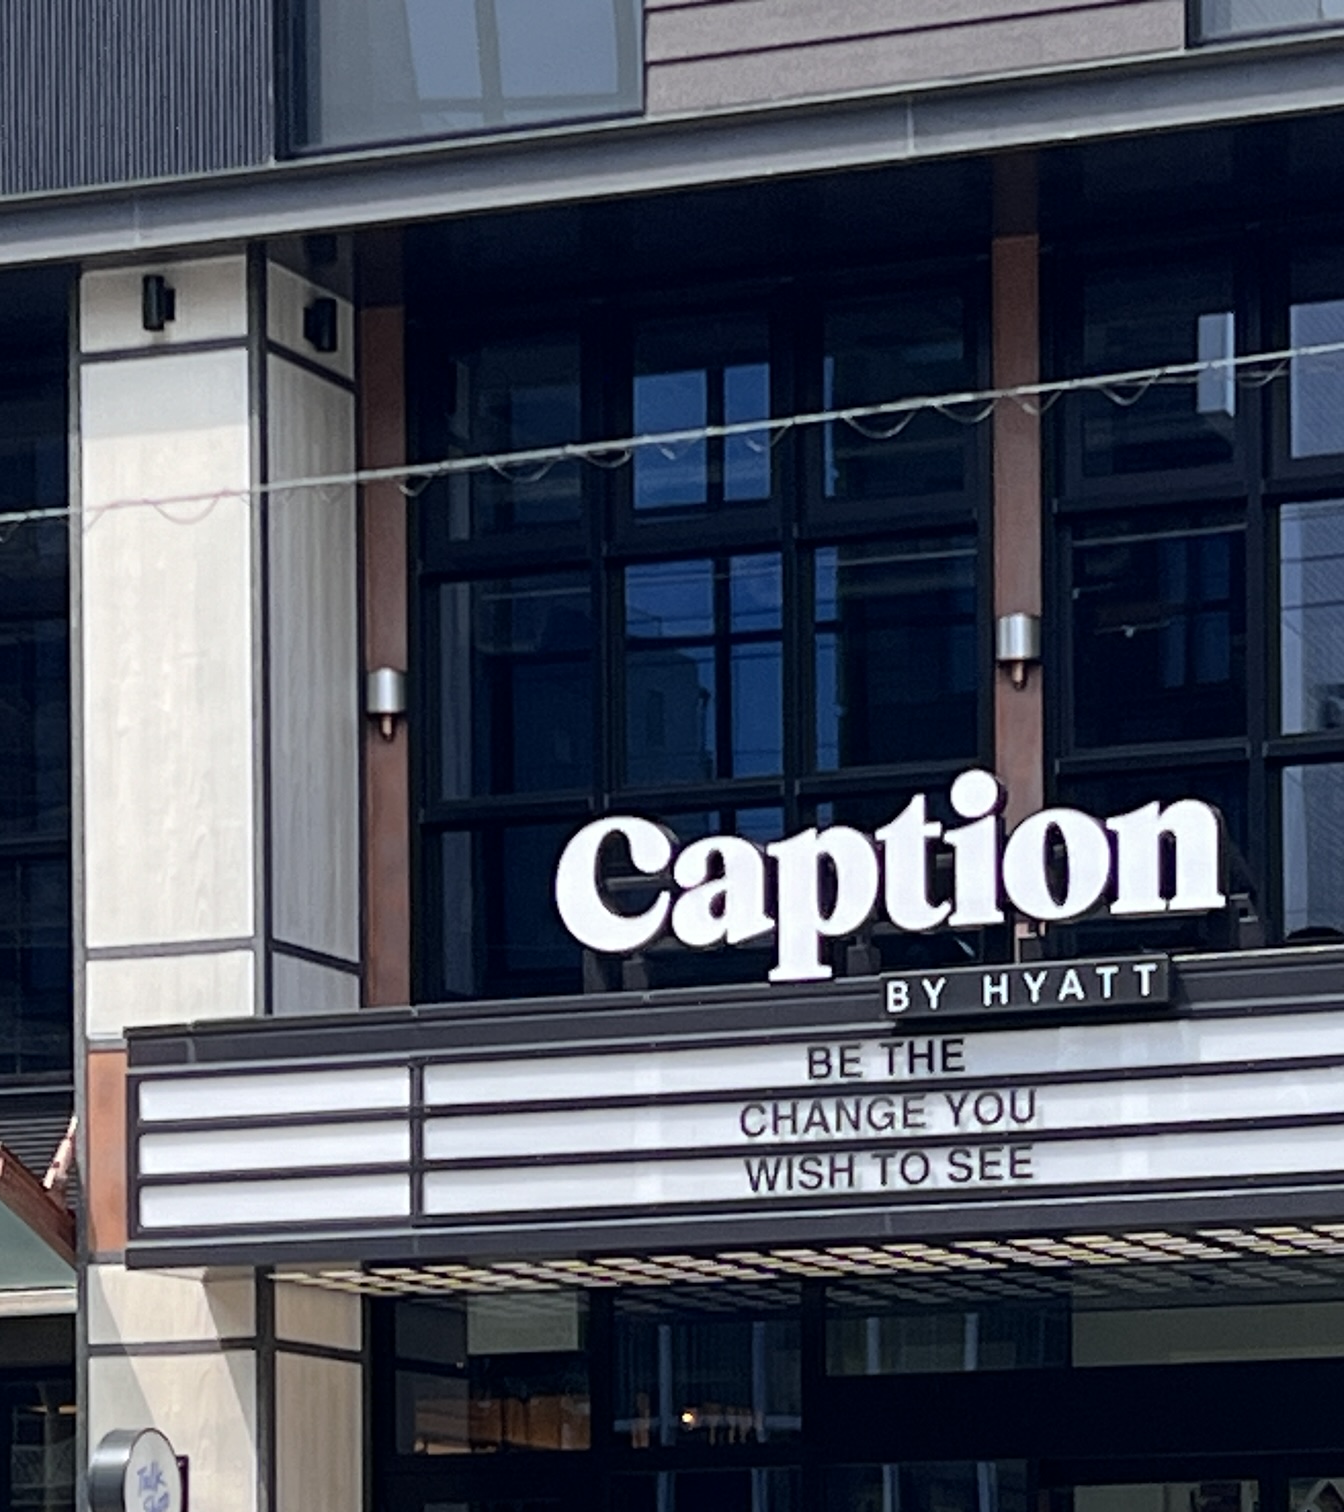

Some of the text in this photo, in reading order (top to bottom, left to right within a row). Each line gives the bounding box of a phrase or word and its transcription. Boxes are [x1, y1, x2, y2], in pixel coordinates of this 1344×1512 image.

[554, 768, 1227, 982] Caption
[885, 962, 1160, 1014] BY HYATT
[807, 1038, 966, 1080] BE THE
[739, 1088, 1038, 1138] CHANGE YOU
[745, 1145, 1035, 1194] WISH TO SEE
